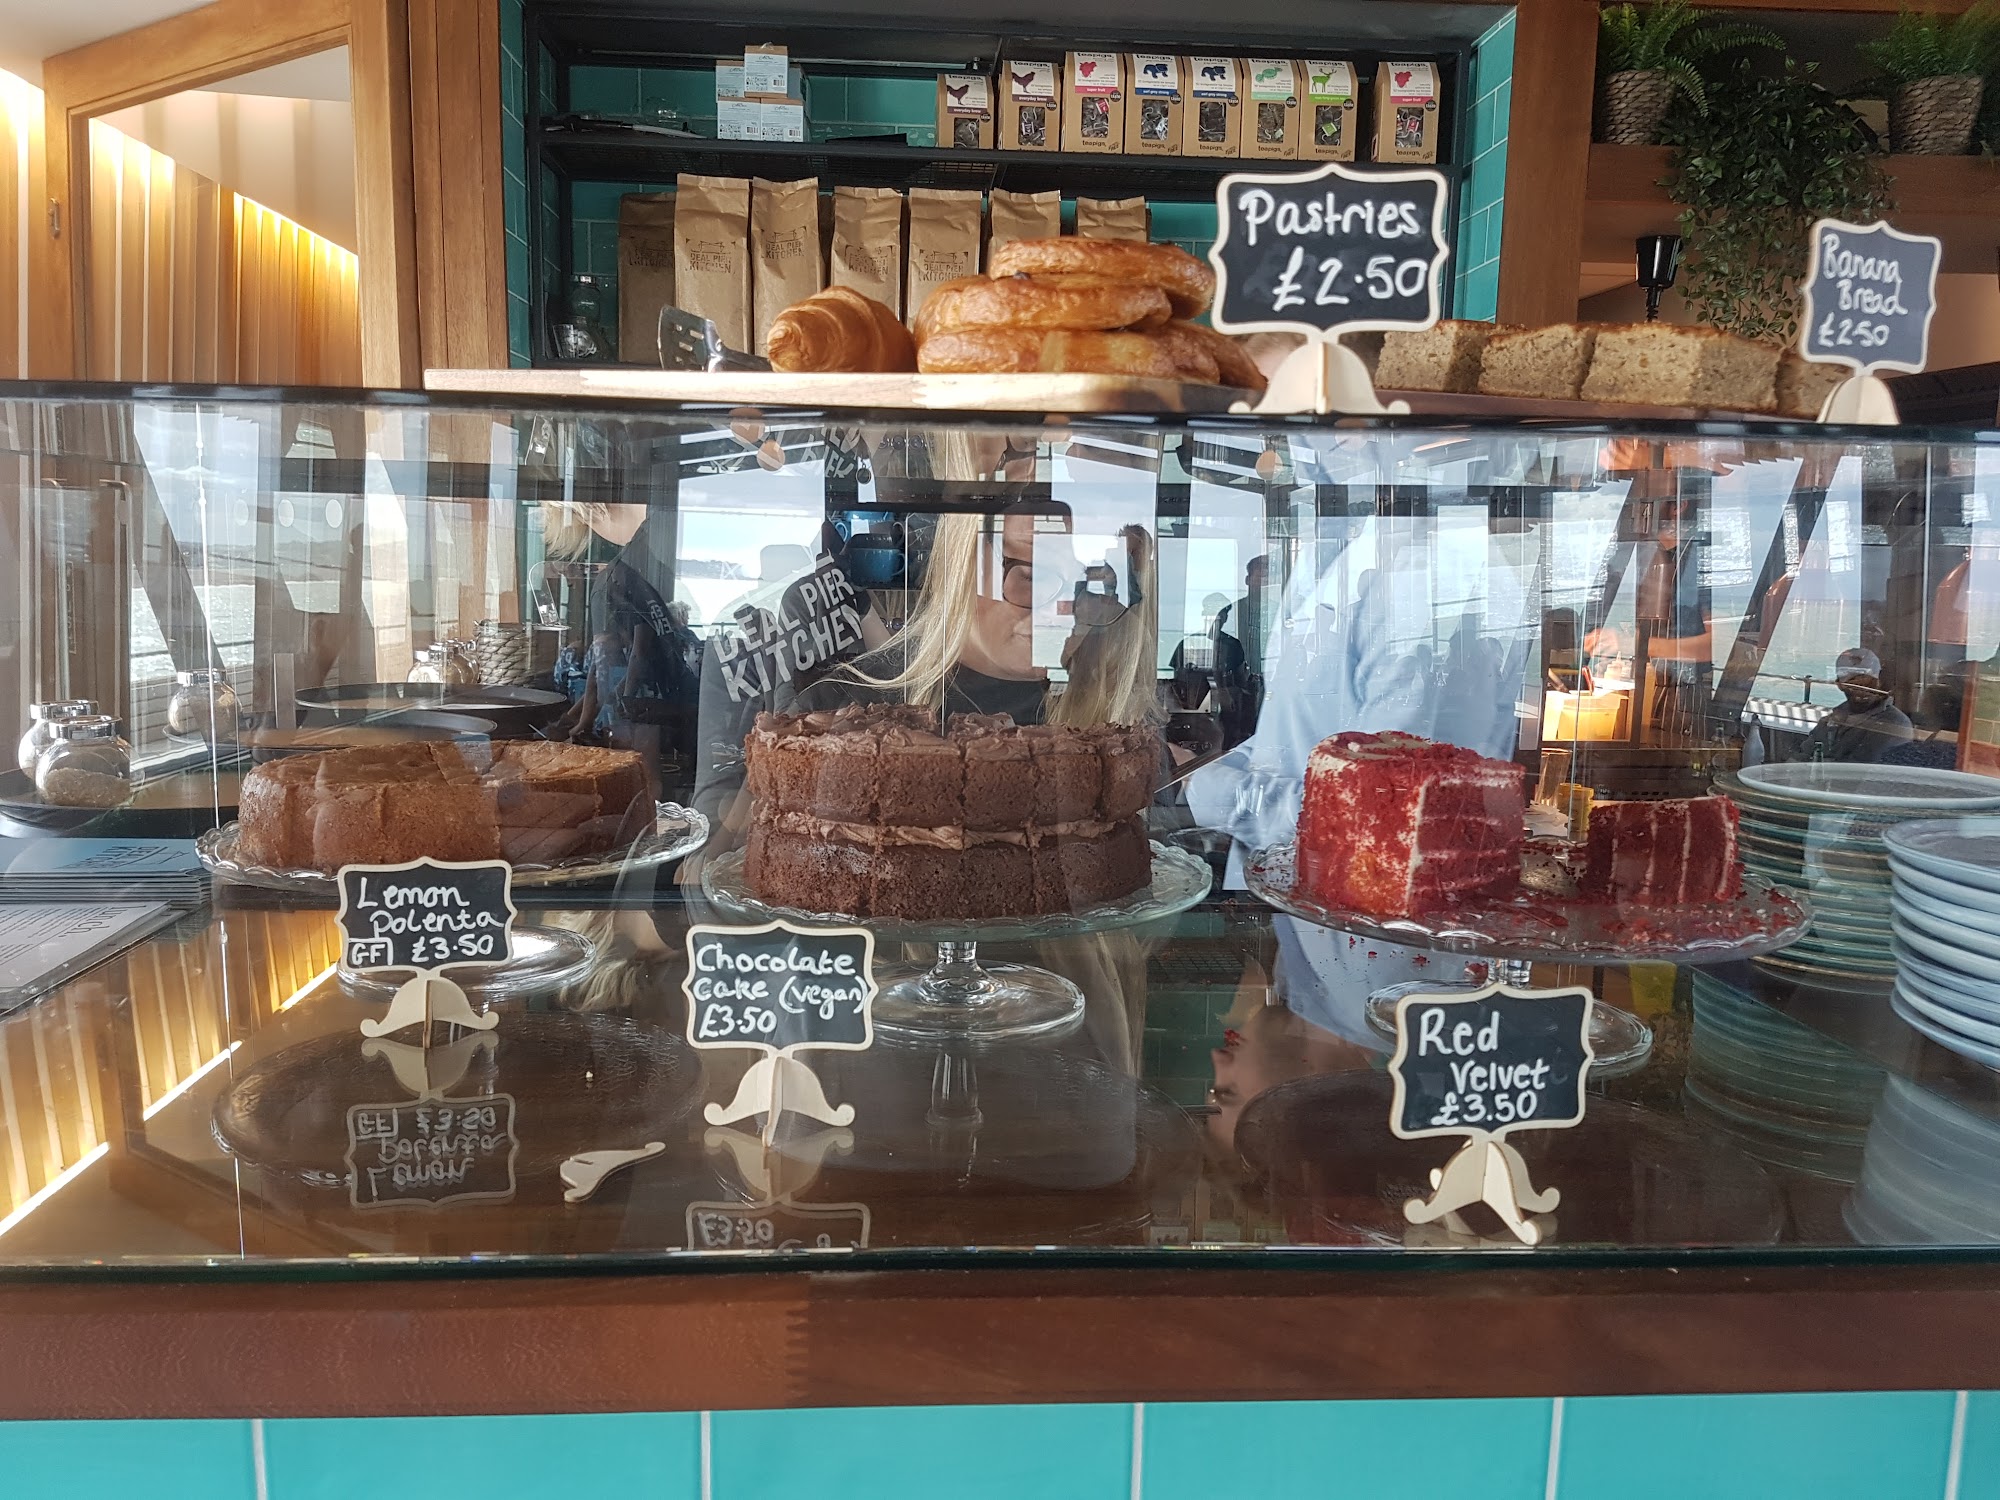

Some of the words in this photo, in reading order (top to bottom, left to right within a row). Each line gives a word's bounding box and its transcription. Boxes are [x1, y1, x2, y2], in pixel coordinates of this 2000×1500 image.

[1238, 188, 1421, 246] Pastries
[690, 252, 711, 262] DEAL
[766, 242, 784, 251] DEAL
[766, 247, 804, 259] KITCHEN
[1821, 232, 1903, 283] Banana
[690, 260, 731, 273] KITCHEN
[1272, 245, 1428, 312] £2.50
[1836, 278, 1909, 316] Bread
[713, 603, 801, 663] DEAL
[799, 568, 855, 618] PIER
[721, 599, 863, 702] KITCHEN
[357, 877, 470, 910] Lemon
[369, 908, 505, 939] Polenta
[351, 943, 386, 965] GF
[411, 933, 494, 963] £3.50
[696, 942, 856, 976] Chocolate
[699, 1002, 777, 1039] £3.50
[1418, 1007, 1500, 1057] Red
[1450, 1058, 1550, 1095] Velvet
[1430, 1090, 1538, 1126] £3.50
